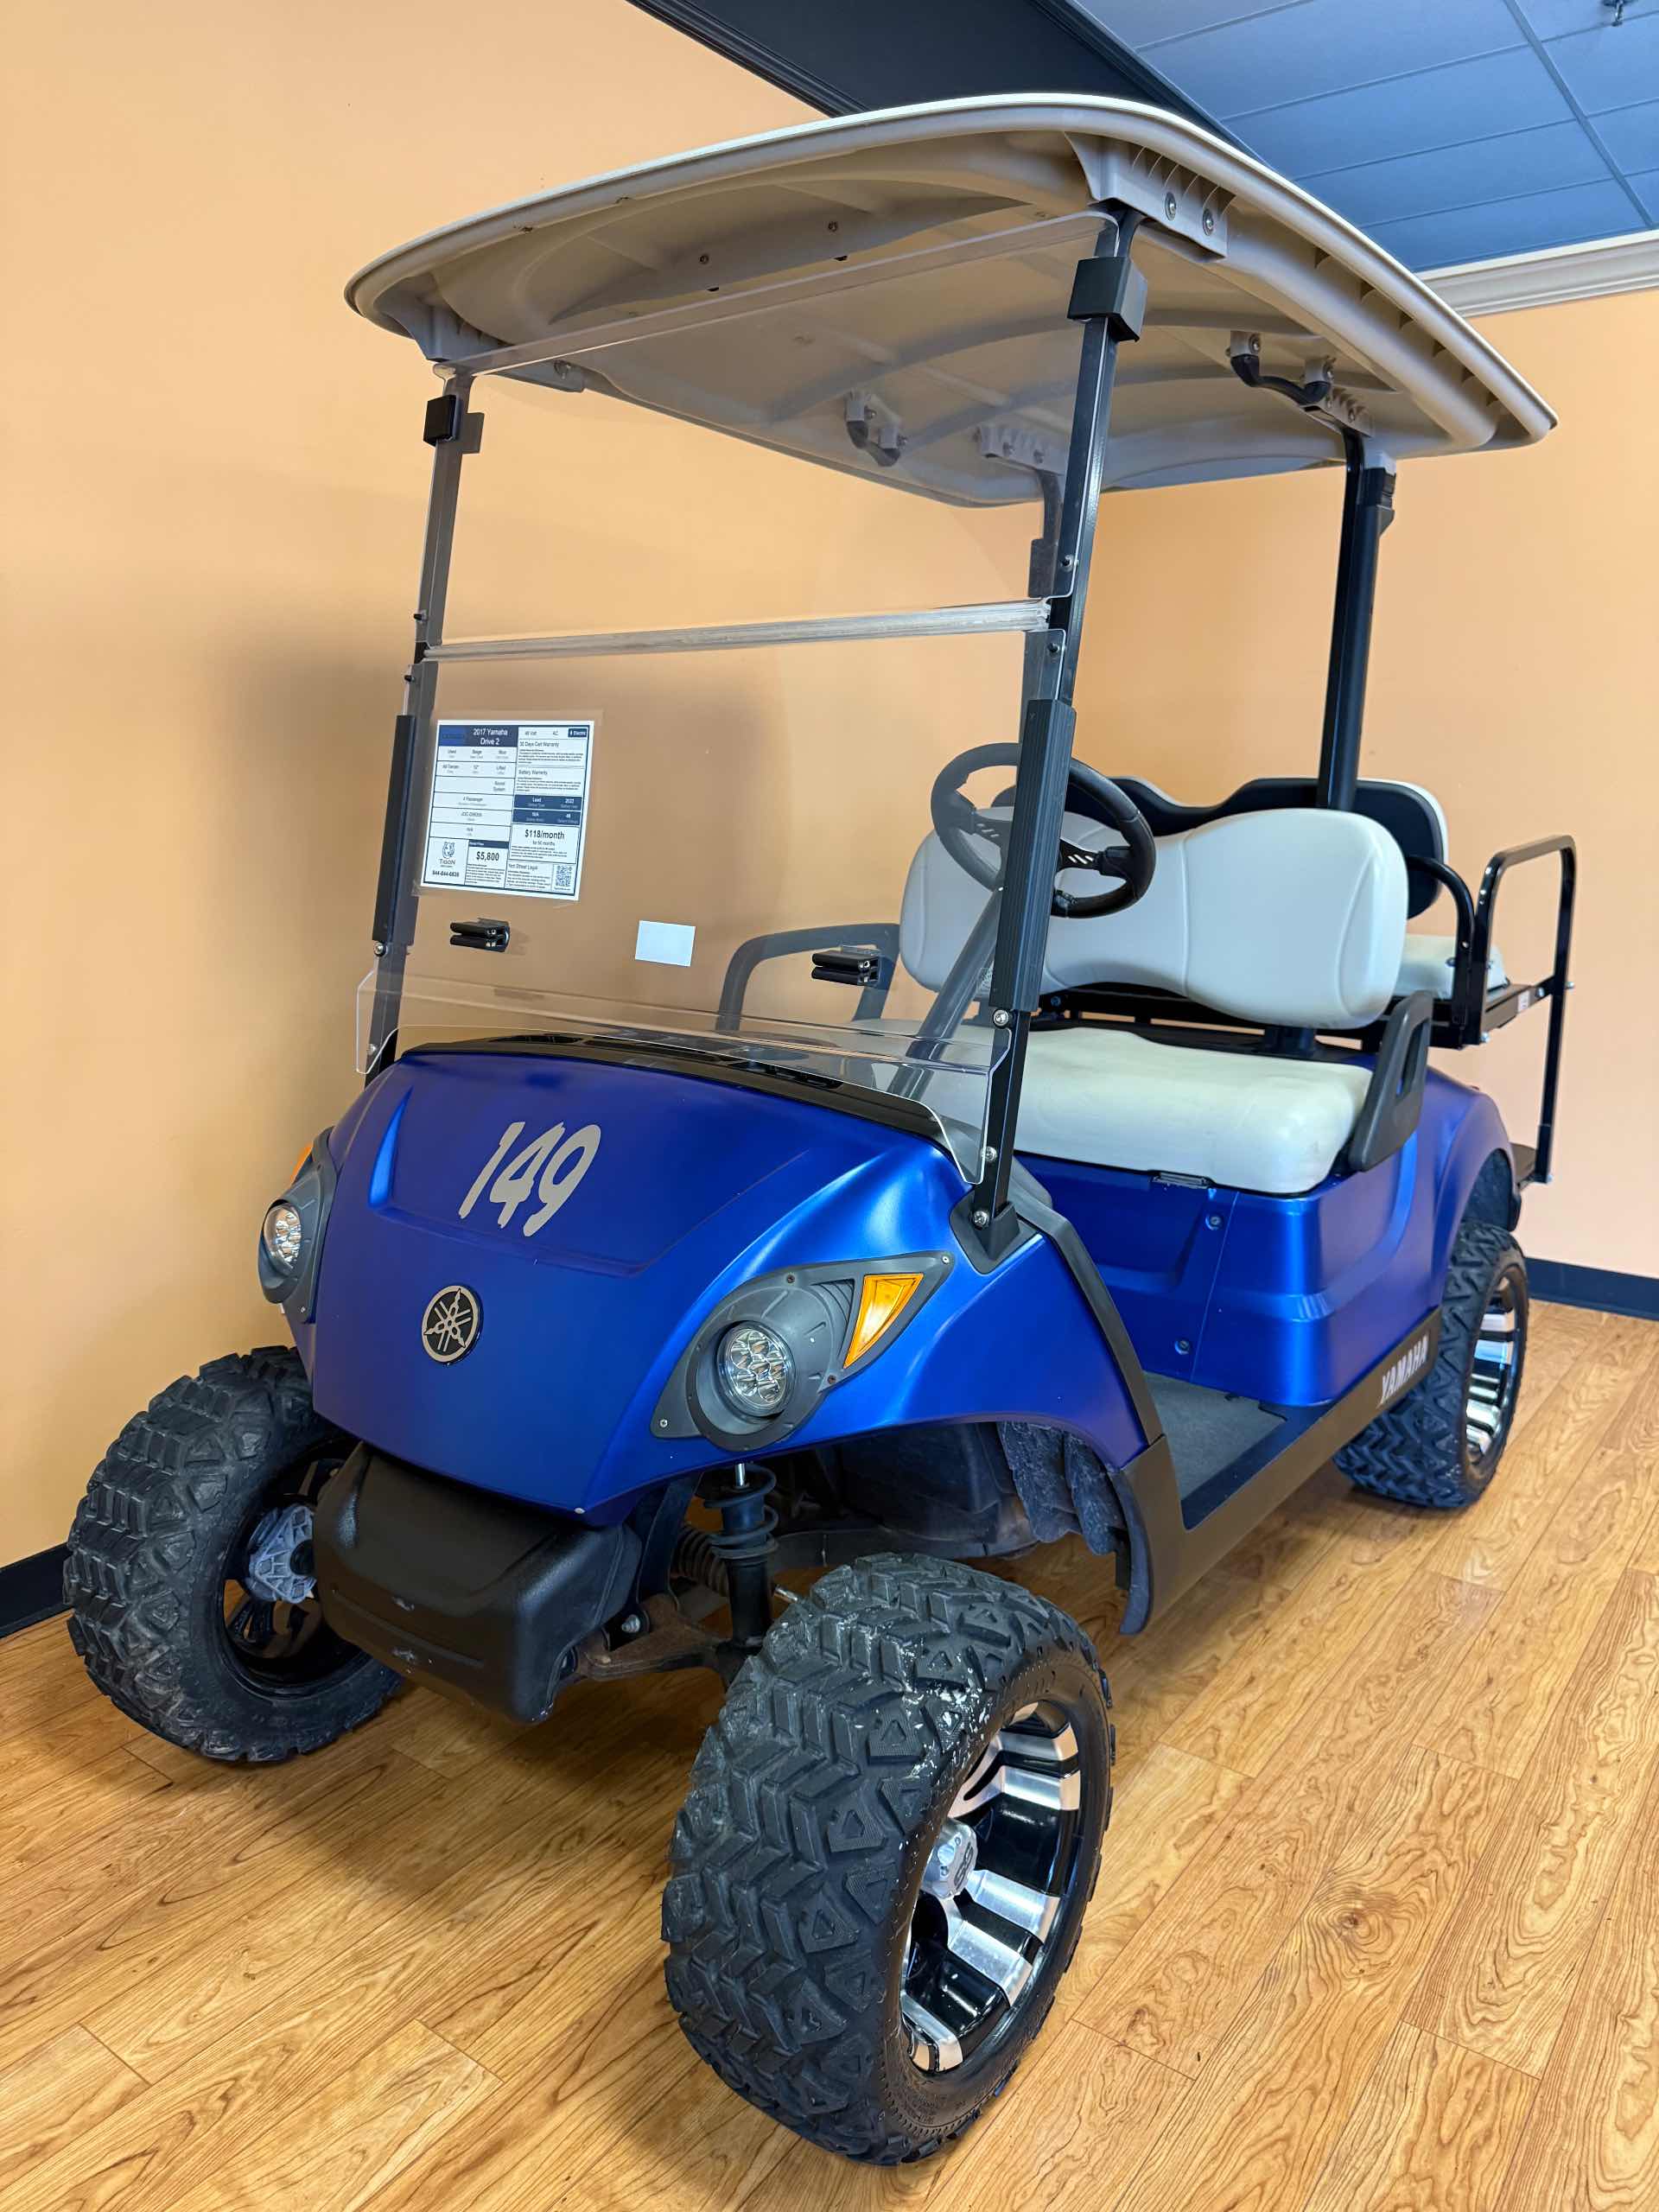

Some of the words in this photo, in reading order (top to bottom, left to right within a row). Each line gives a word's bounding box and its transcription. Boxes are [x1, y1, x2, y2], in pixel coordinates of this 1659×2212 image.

[524, 830, 564, 839] $118/month
[458, 1122, 601, 1236] 149
[1379, 1334, 1429, 1406] YAMAHA
